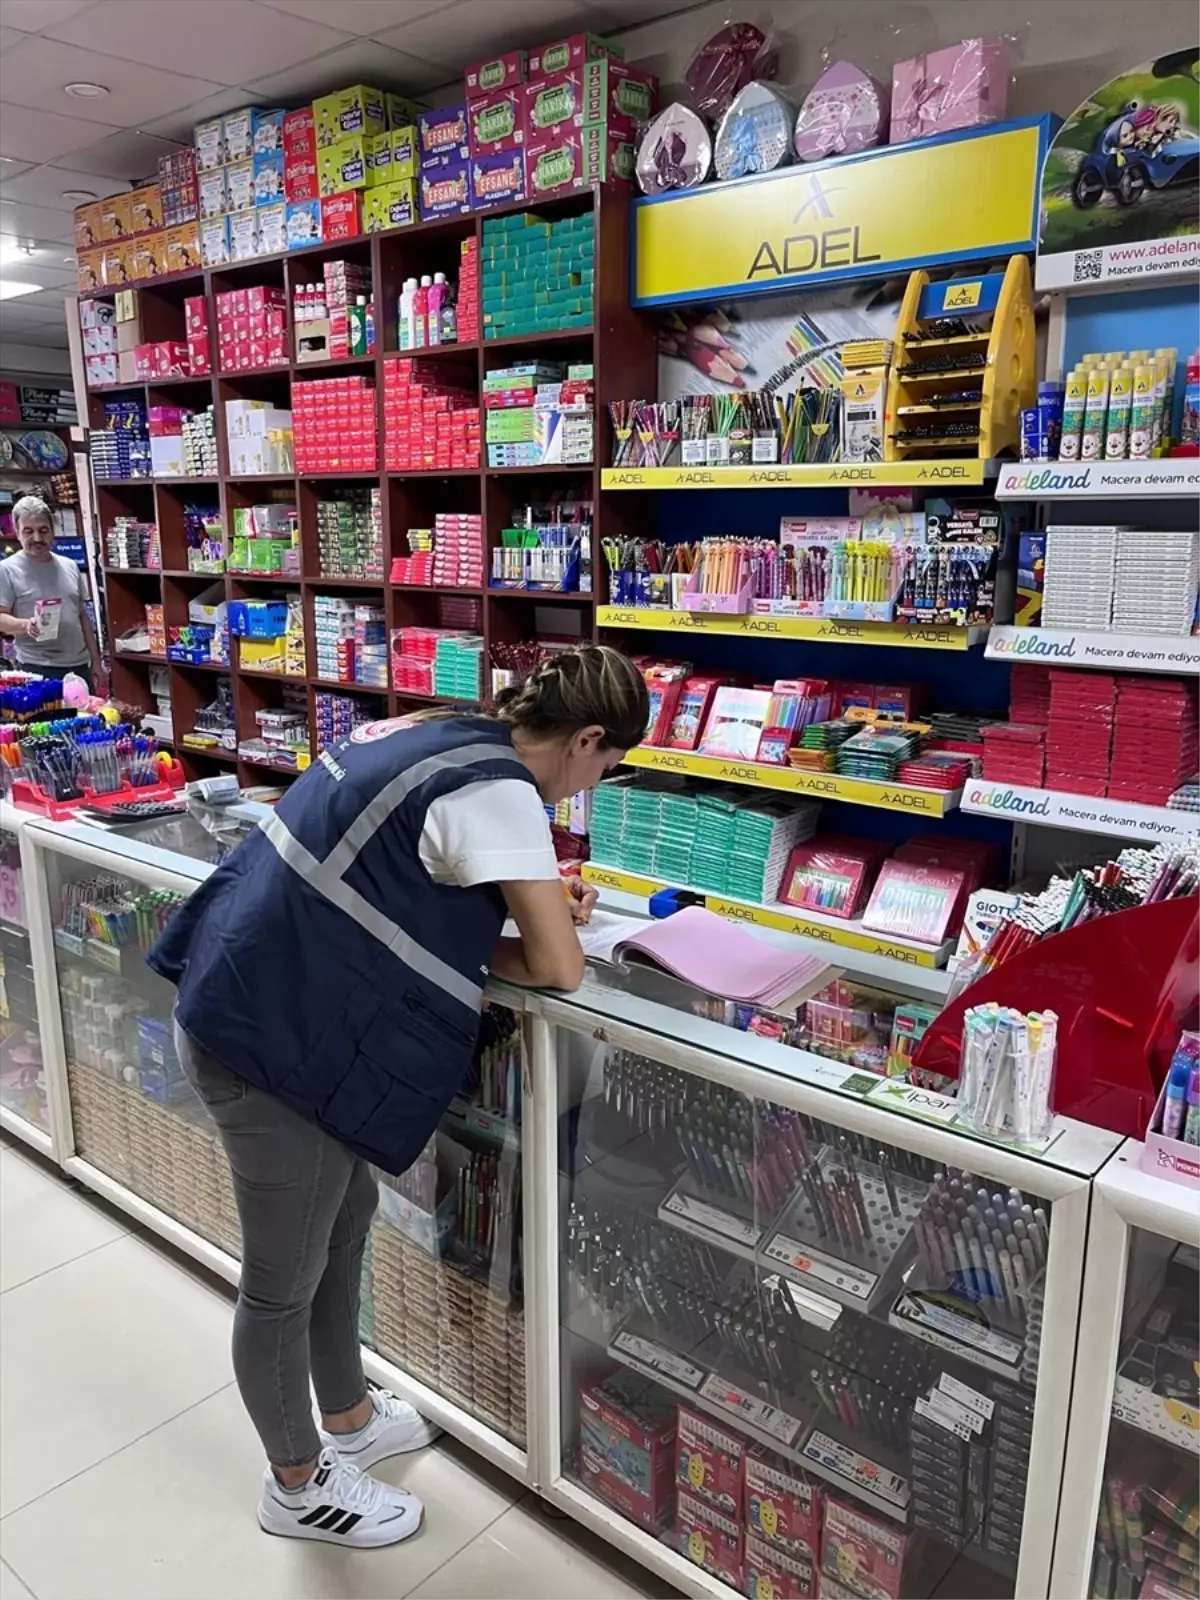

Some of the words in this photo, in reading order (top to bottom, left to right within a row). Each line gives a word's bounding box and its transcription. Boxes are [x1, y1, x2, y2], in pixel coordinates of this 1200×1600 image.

[427, 124, 460, 146] EFSANE
[480, 171, 515, 193] EFSANE
[428, 183, 461, 203] EFSANE
[746, 225, 881, 279] ADEL
[1107, 262, 1144, 276] Macera
[1145, 258, 1180, 272] devam
[946, 296, 975, 307] ADEL
[618, 473, 646, 484] ADEL
[685, 472, 715, 483] ADEL
[758, 471, 792, 482] ADEL
[839, 469, 876, 480] ADEL
[930, 466, 970, 478] ADEL
[1005, 467, 1091, 490] adeland
[1100, 474, 1141, 485] Macera
[1144, 473, 1185, 484] devam
[612, 613, 640, 624] ADEL
[678, 617, 708, 628] ADEL
[750, 621, 782, 633] ADEL
[829, 625, 864, 637] ADEL
[915, 629, 955, 643] ADEL
[993, 633, 1076, 657] adeland
[1084, 646, 1124, 658] Macera
[1126, 649, 1166, 660] devam
[660, 757, 688, 769] ADEL
[729, 767, 761, 780] ADEL
[807, 779, 841, 794] ADEL
[892, 794, 930, 810] ADEL
[969, 788, 1050, 816] adeland
[1058, 806, 1097, 821] Macera
[1099, 813, 1136, 828] devam
[597, 874, 623, 887] ADEL
[726, 906, 758, 922] ADEL
[976, 901, 1013, 916] GIOTT
[802, 926, 836, 943] ADEL
[884, 948, 923, 966] ADEL
